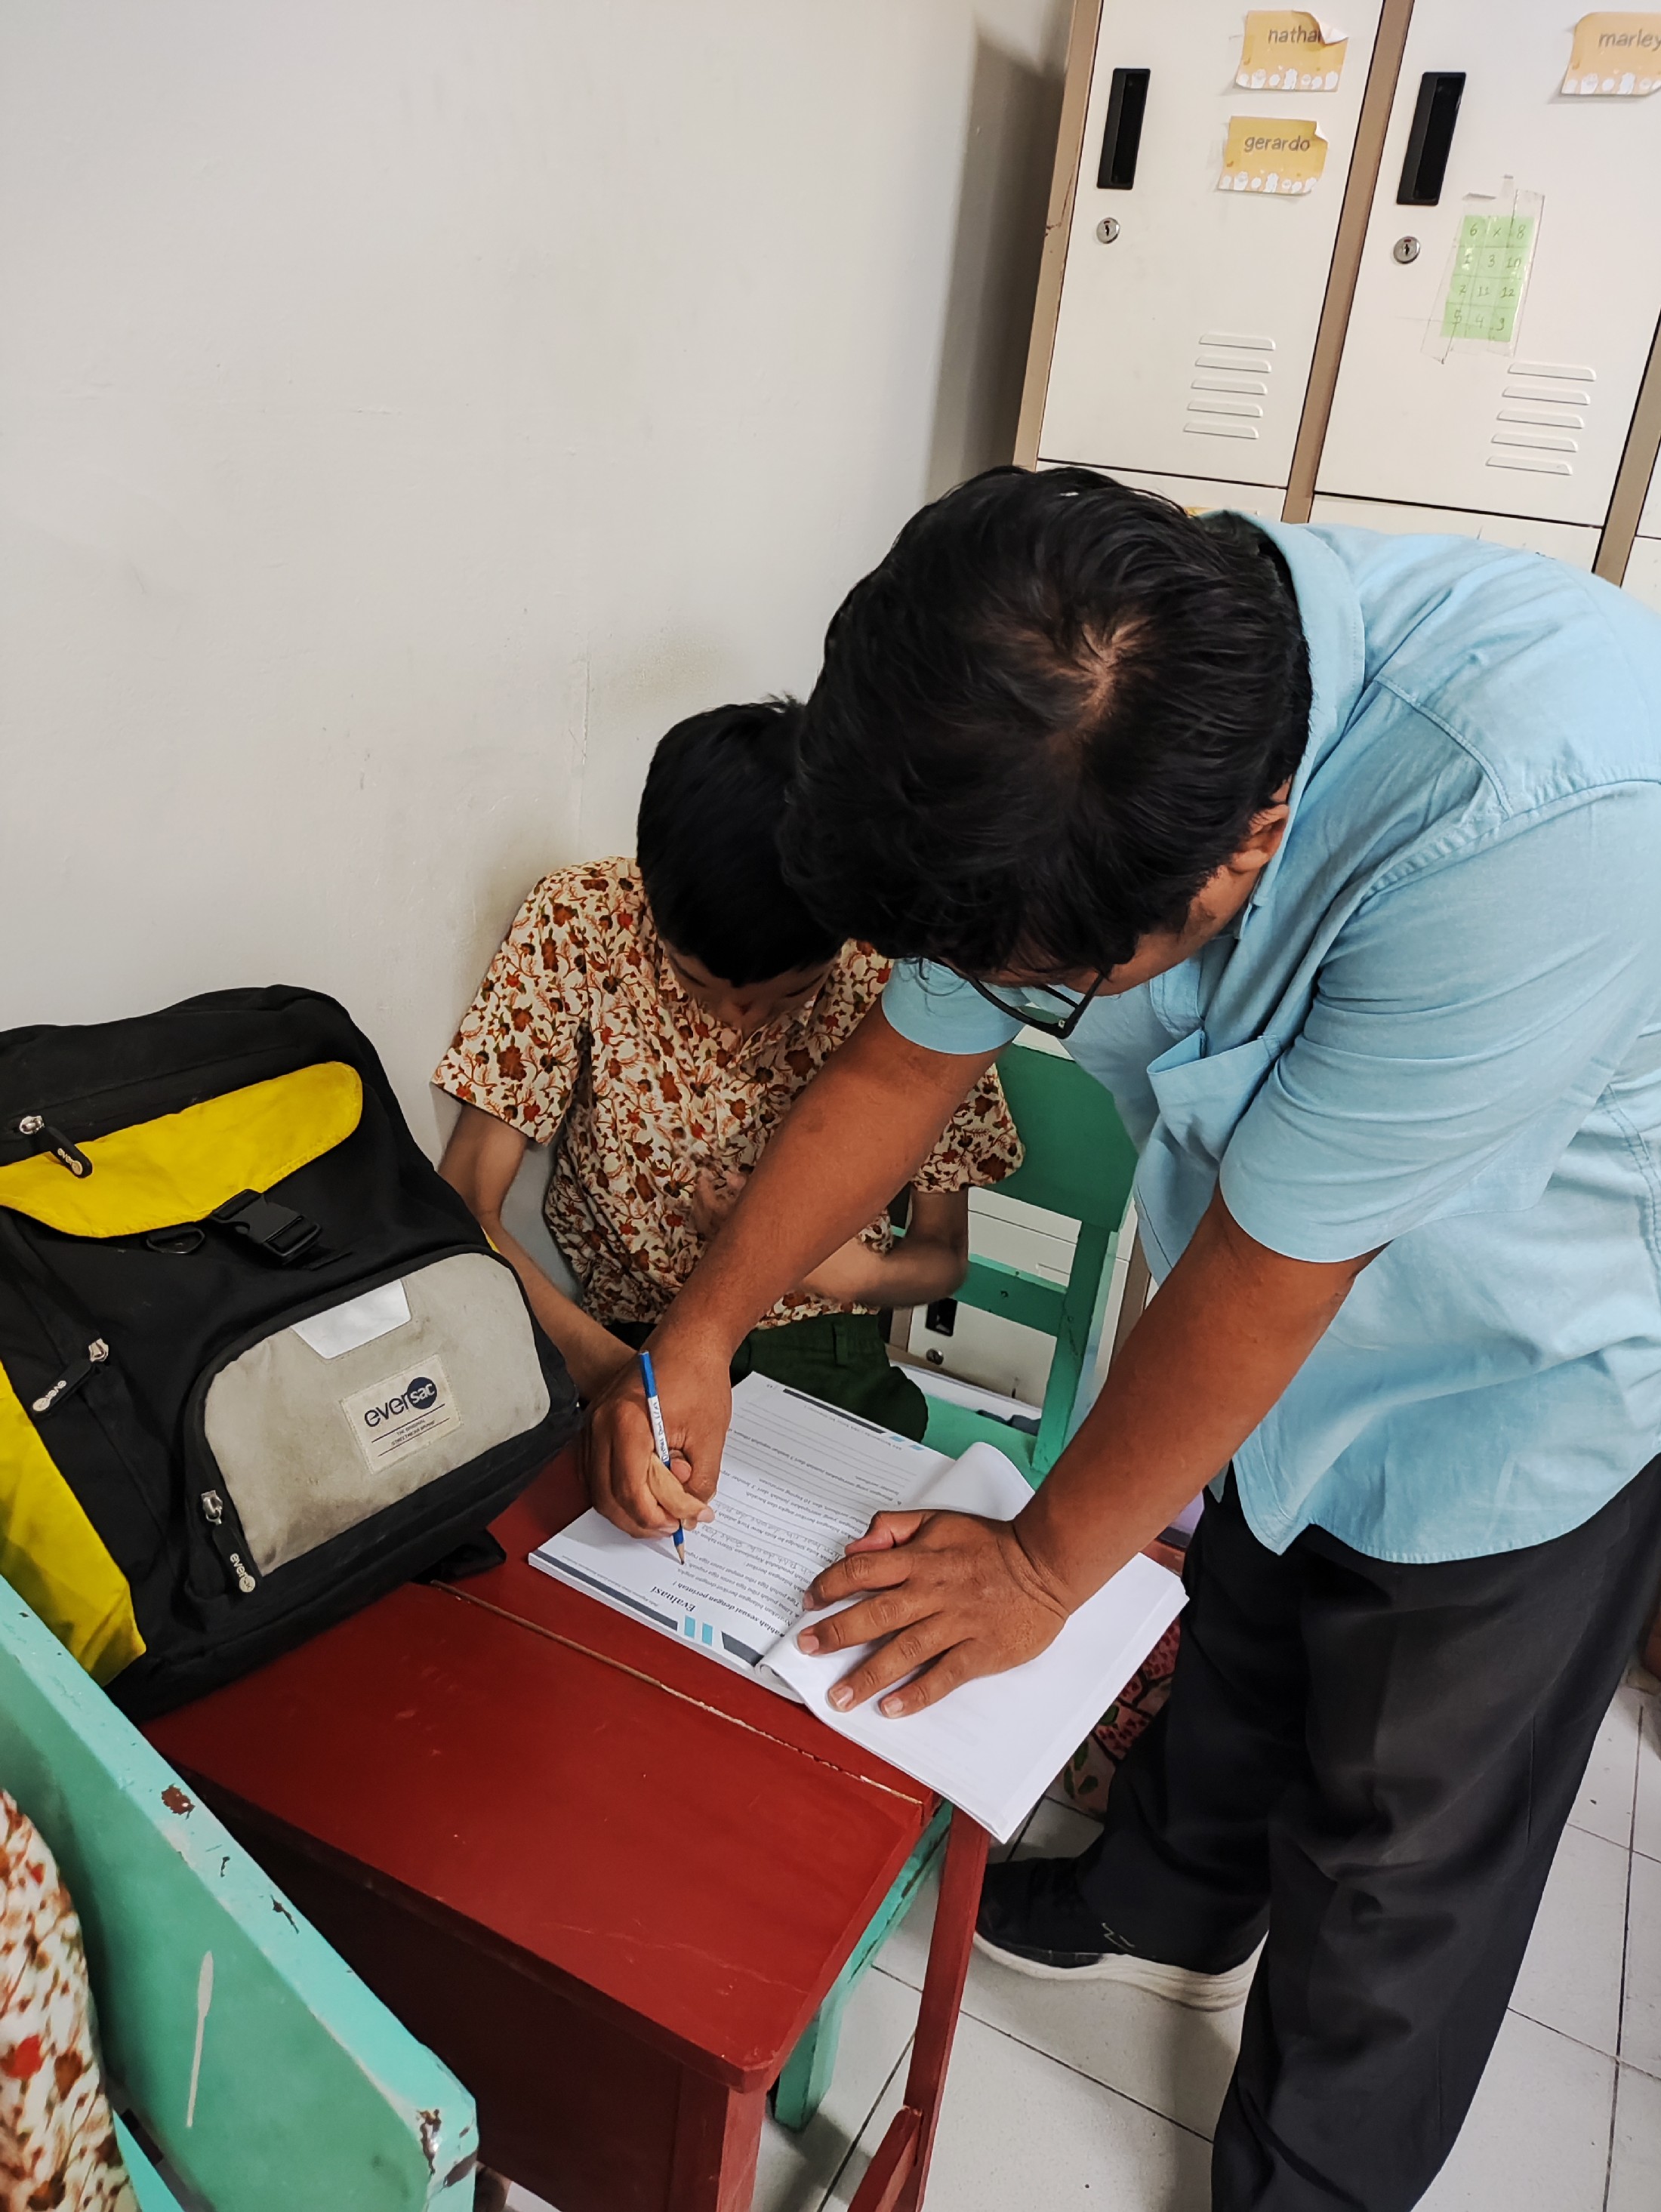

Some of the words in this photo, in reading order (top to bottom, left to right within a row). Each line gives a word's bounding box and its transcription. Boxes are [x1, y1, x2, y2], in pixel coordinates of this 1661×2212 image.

[1598, 28, 1661, 52] marley
[1243, 135, 1310, 153] gerardo
[1470, 223, 1478, 236] 6
[1516, 225, 1526, 240] 8
[1487, 254, 1495, 268] 3
[1506, 257, 1522, 269] 10
[1499, 286, 1516, 298] 12
[1475, 313, 1484, 329] 4
[364, 1377, 438, 1428] eversac
[677, 1582, 710, 1598] perintah
[650, 1586, 696, 1612] Evaluasi
[708, 1596, 735, 1610] dengan
